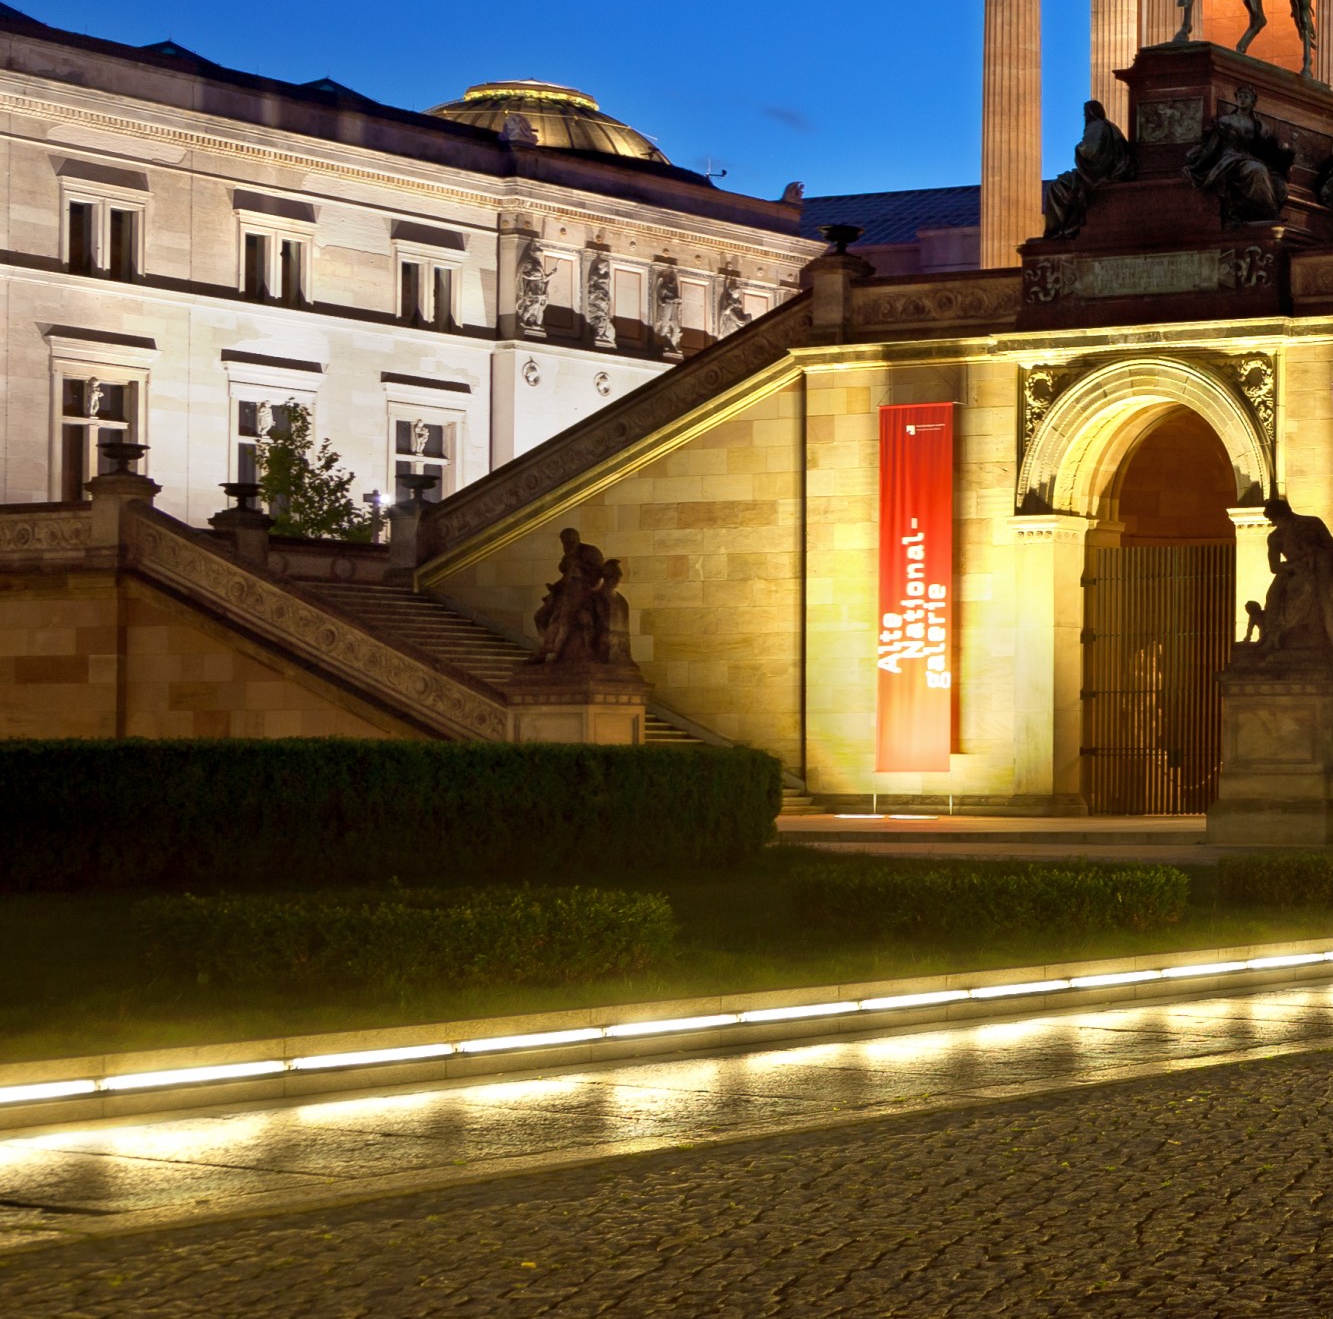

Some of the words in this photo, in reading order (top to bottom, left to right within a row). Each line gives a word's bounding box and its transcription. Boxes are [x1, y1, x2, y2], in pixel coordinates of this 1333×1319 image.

[900, 518, 925, 658] National-
[923, 583, 951, 689] galerie
[878, 612, 902, 673] Alte
